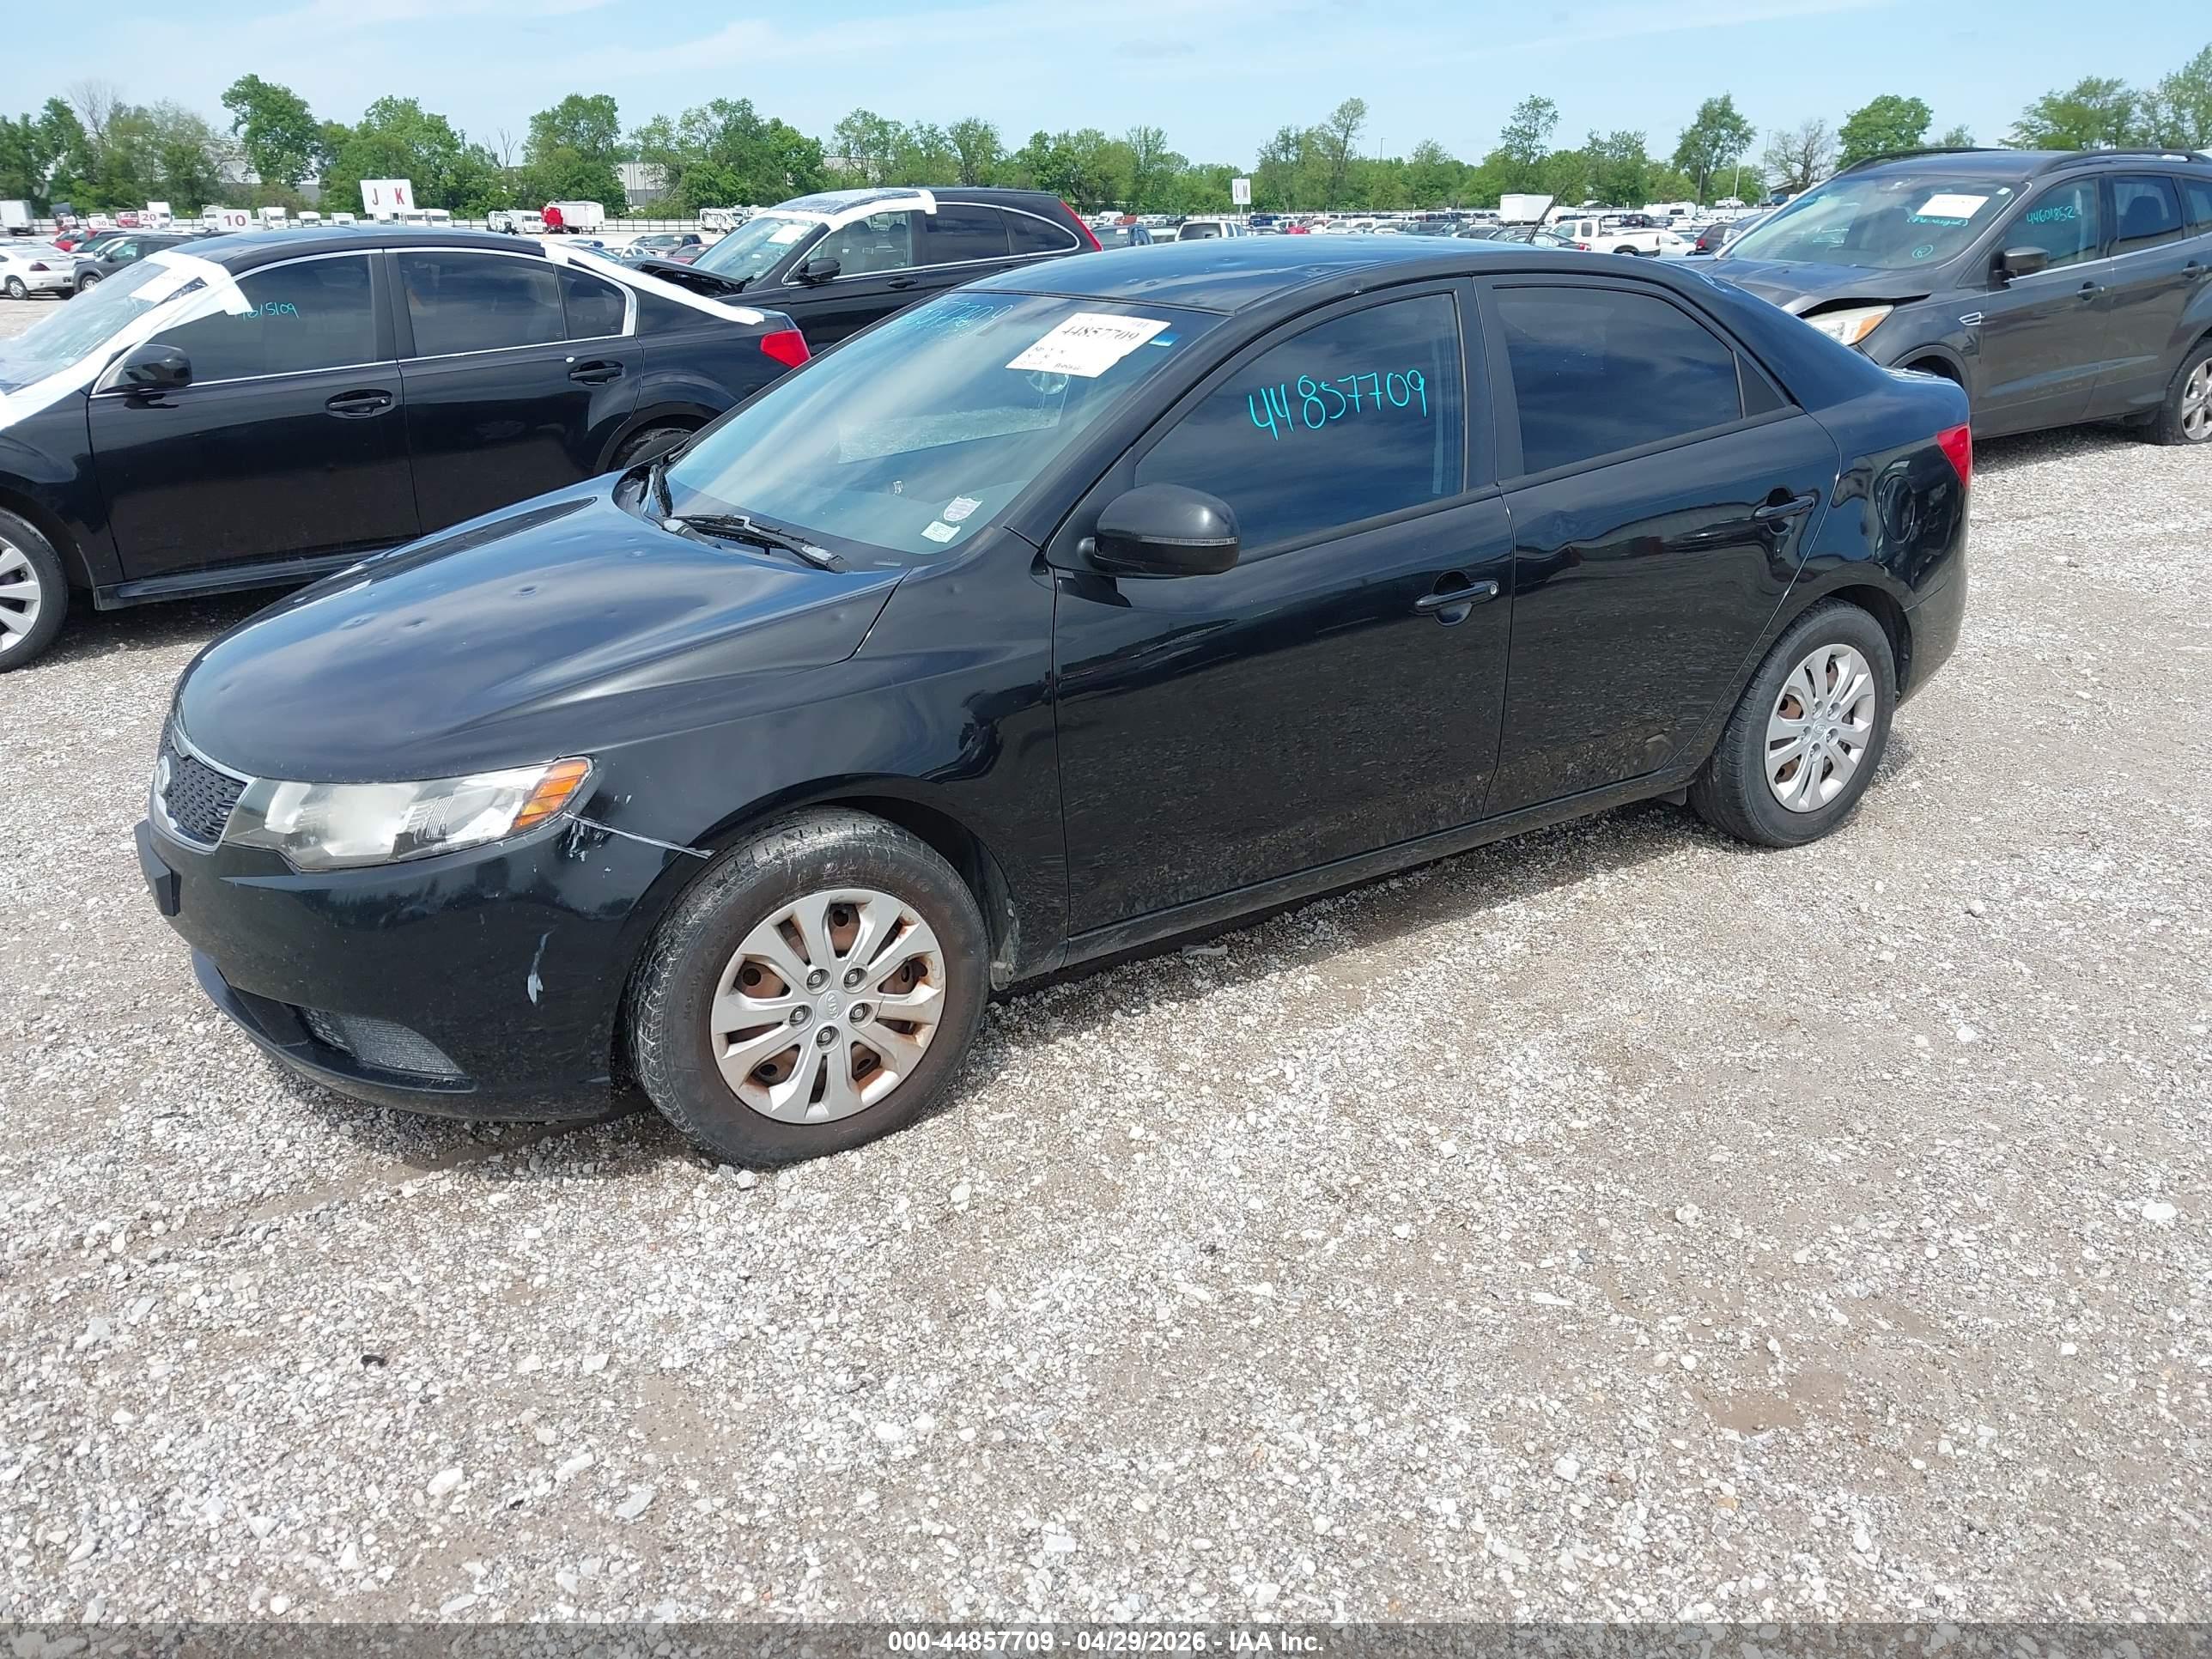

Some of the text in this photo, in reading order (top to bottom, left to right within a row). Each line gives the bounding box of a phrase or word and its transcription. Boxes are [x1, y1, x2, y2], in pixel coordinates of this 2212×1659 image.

[372, 187, 405, 205] J K
[142, 213, 156, 222] 20
[223, 215, 246, 227] 10
[2026, 206, 2076, 225] 44601852
[1061, 325, 1140, 342] 44857709
[1249, 369, 1427, 441] 44857709
